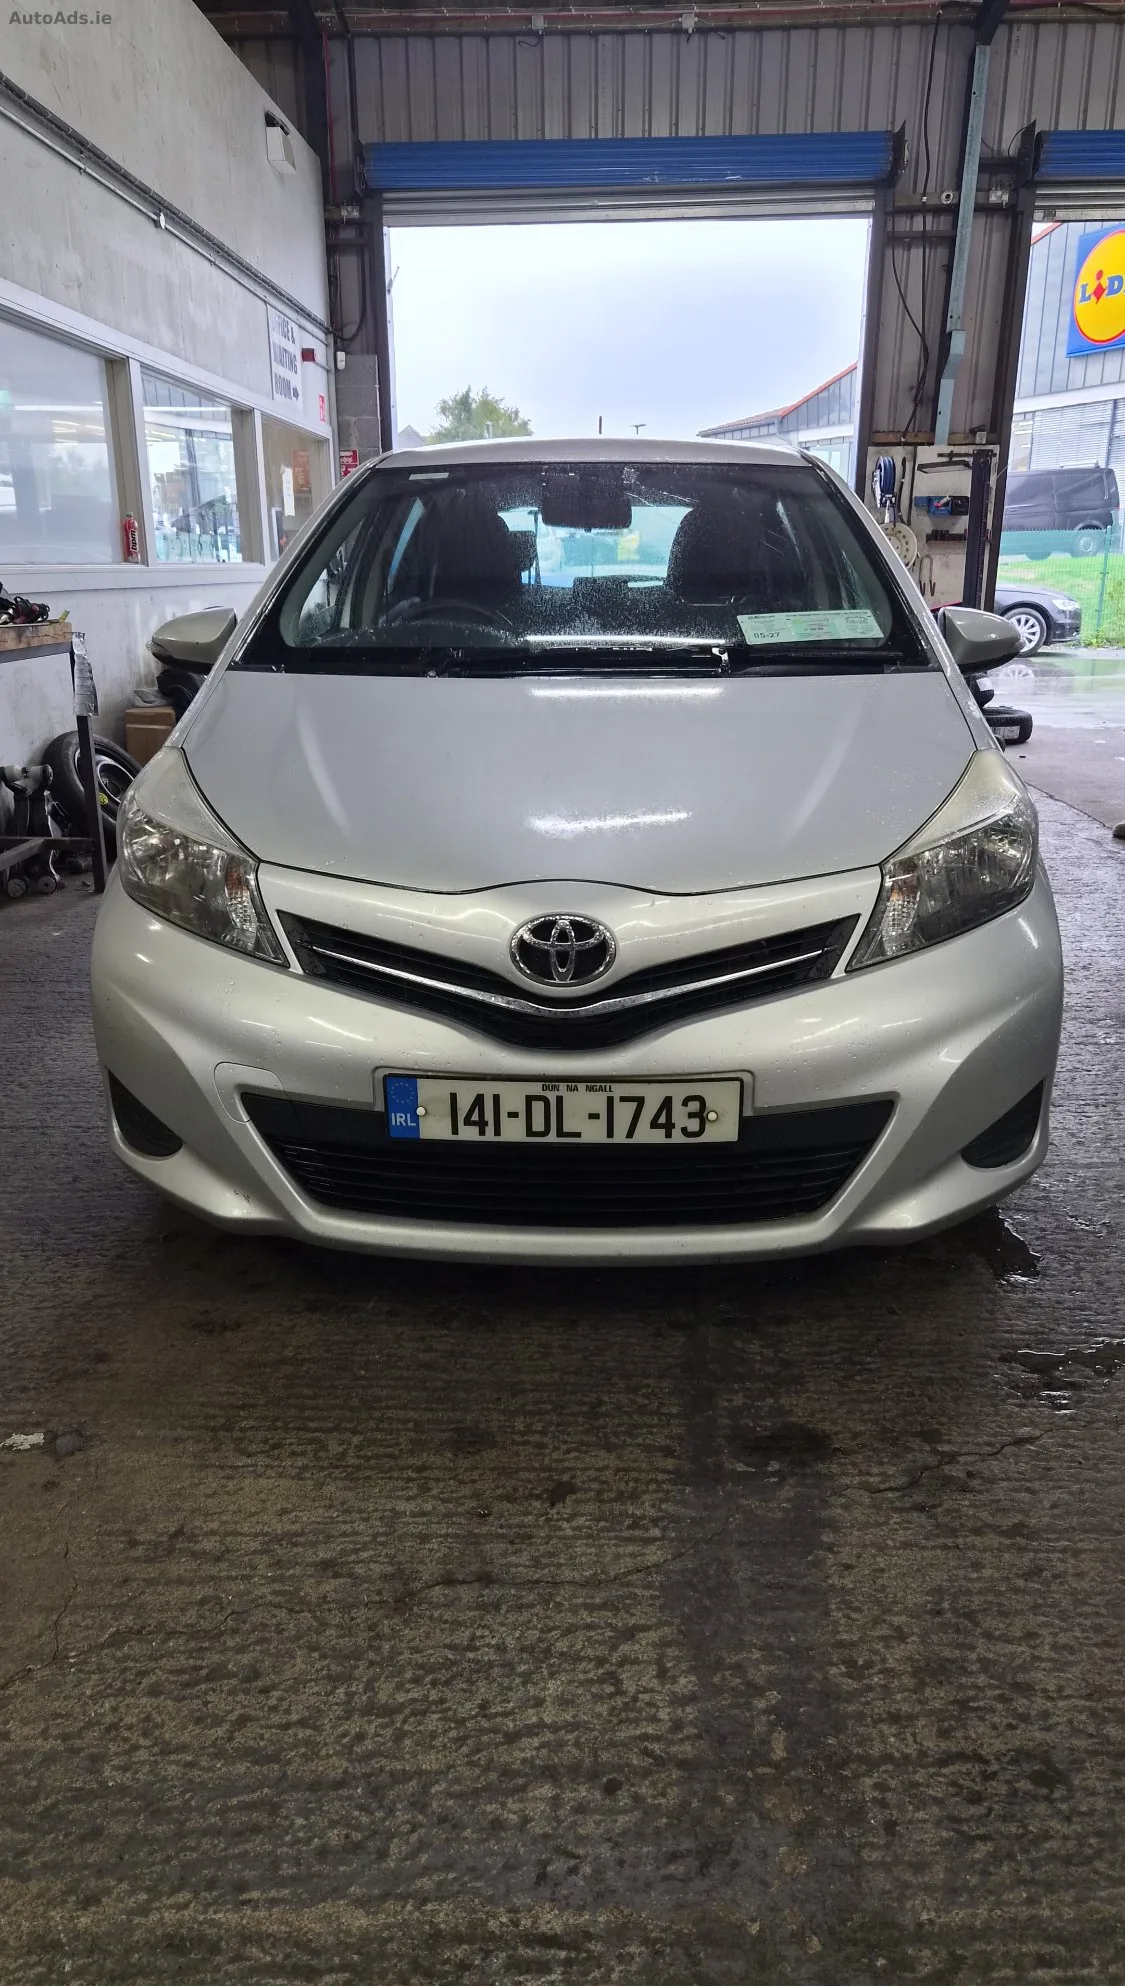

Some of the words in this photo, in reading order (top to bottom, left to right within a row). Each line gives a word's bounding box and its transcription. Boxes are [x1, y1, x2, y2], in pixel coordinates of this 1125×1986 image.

[272, 340, 298, 375] WAITING
[274, 371, 293, 401] ROOM
[130, 529, 138, 551] bpm
[753, 631, 780, 639] 05-27
[566, 1084, 579, 1092] NA
[585, 1084, 614, 1093] NGALL
[391, 1112, 417, 1127] IRL
[450, 1092, 707, 1139] 141-DL-1743
